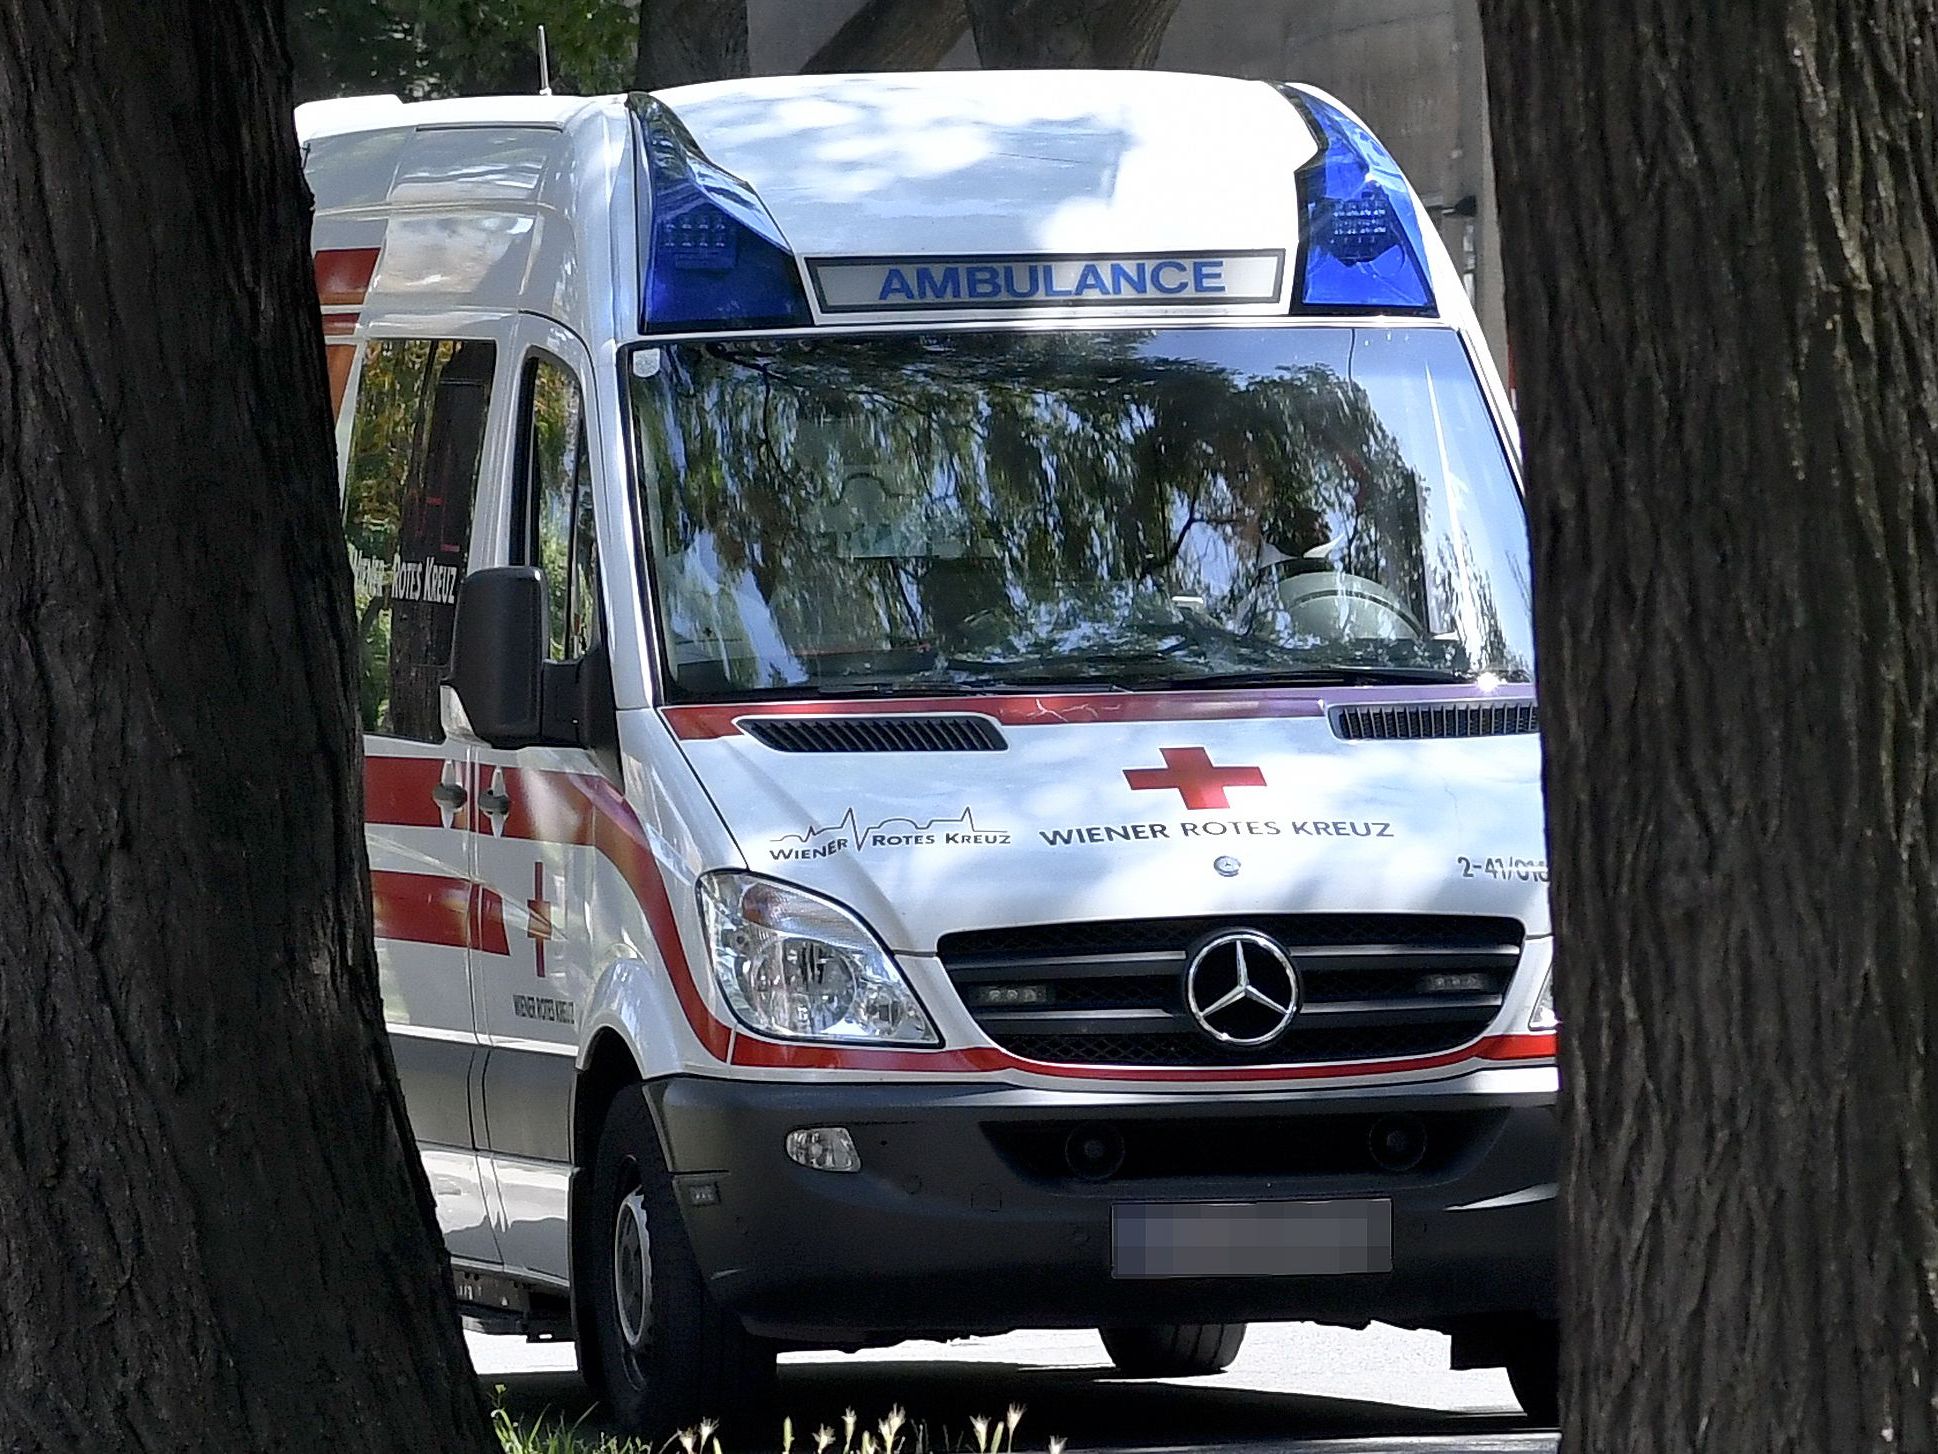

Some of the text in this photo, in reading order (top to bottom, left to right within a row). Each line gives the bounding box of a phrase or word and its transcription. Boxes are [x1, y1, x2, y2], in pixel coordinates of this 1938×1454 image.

[878, 260, 1226, 300] AMBULANCE
[391, 553, 422, 600] ROTES
[423, 556, 457, 604] KREUZ
[769, 832, 1011, 861] WIENER ROTES KREUZ
[1039, 820, 1395, 846] WIENER ROTES KREUZ
